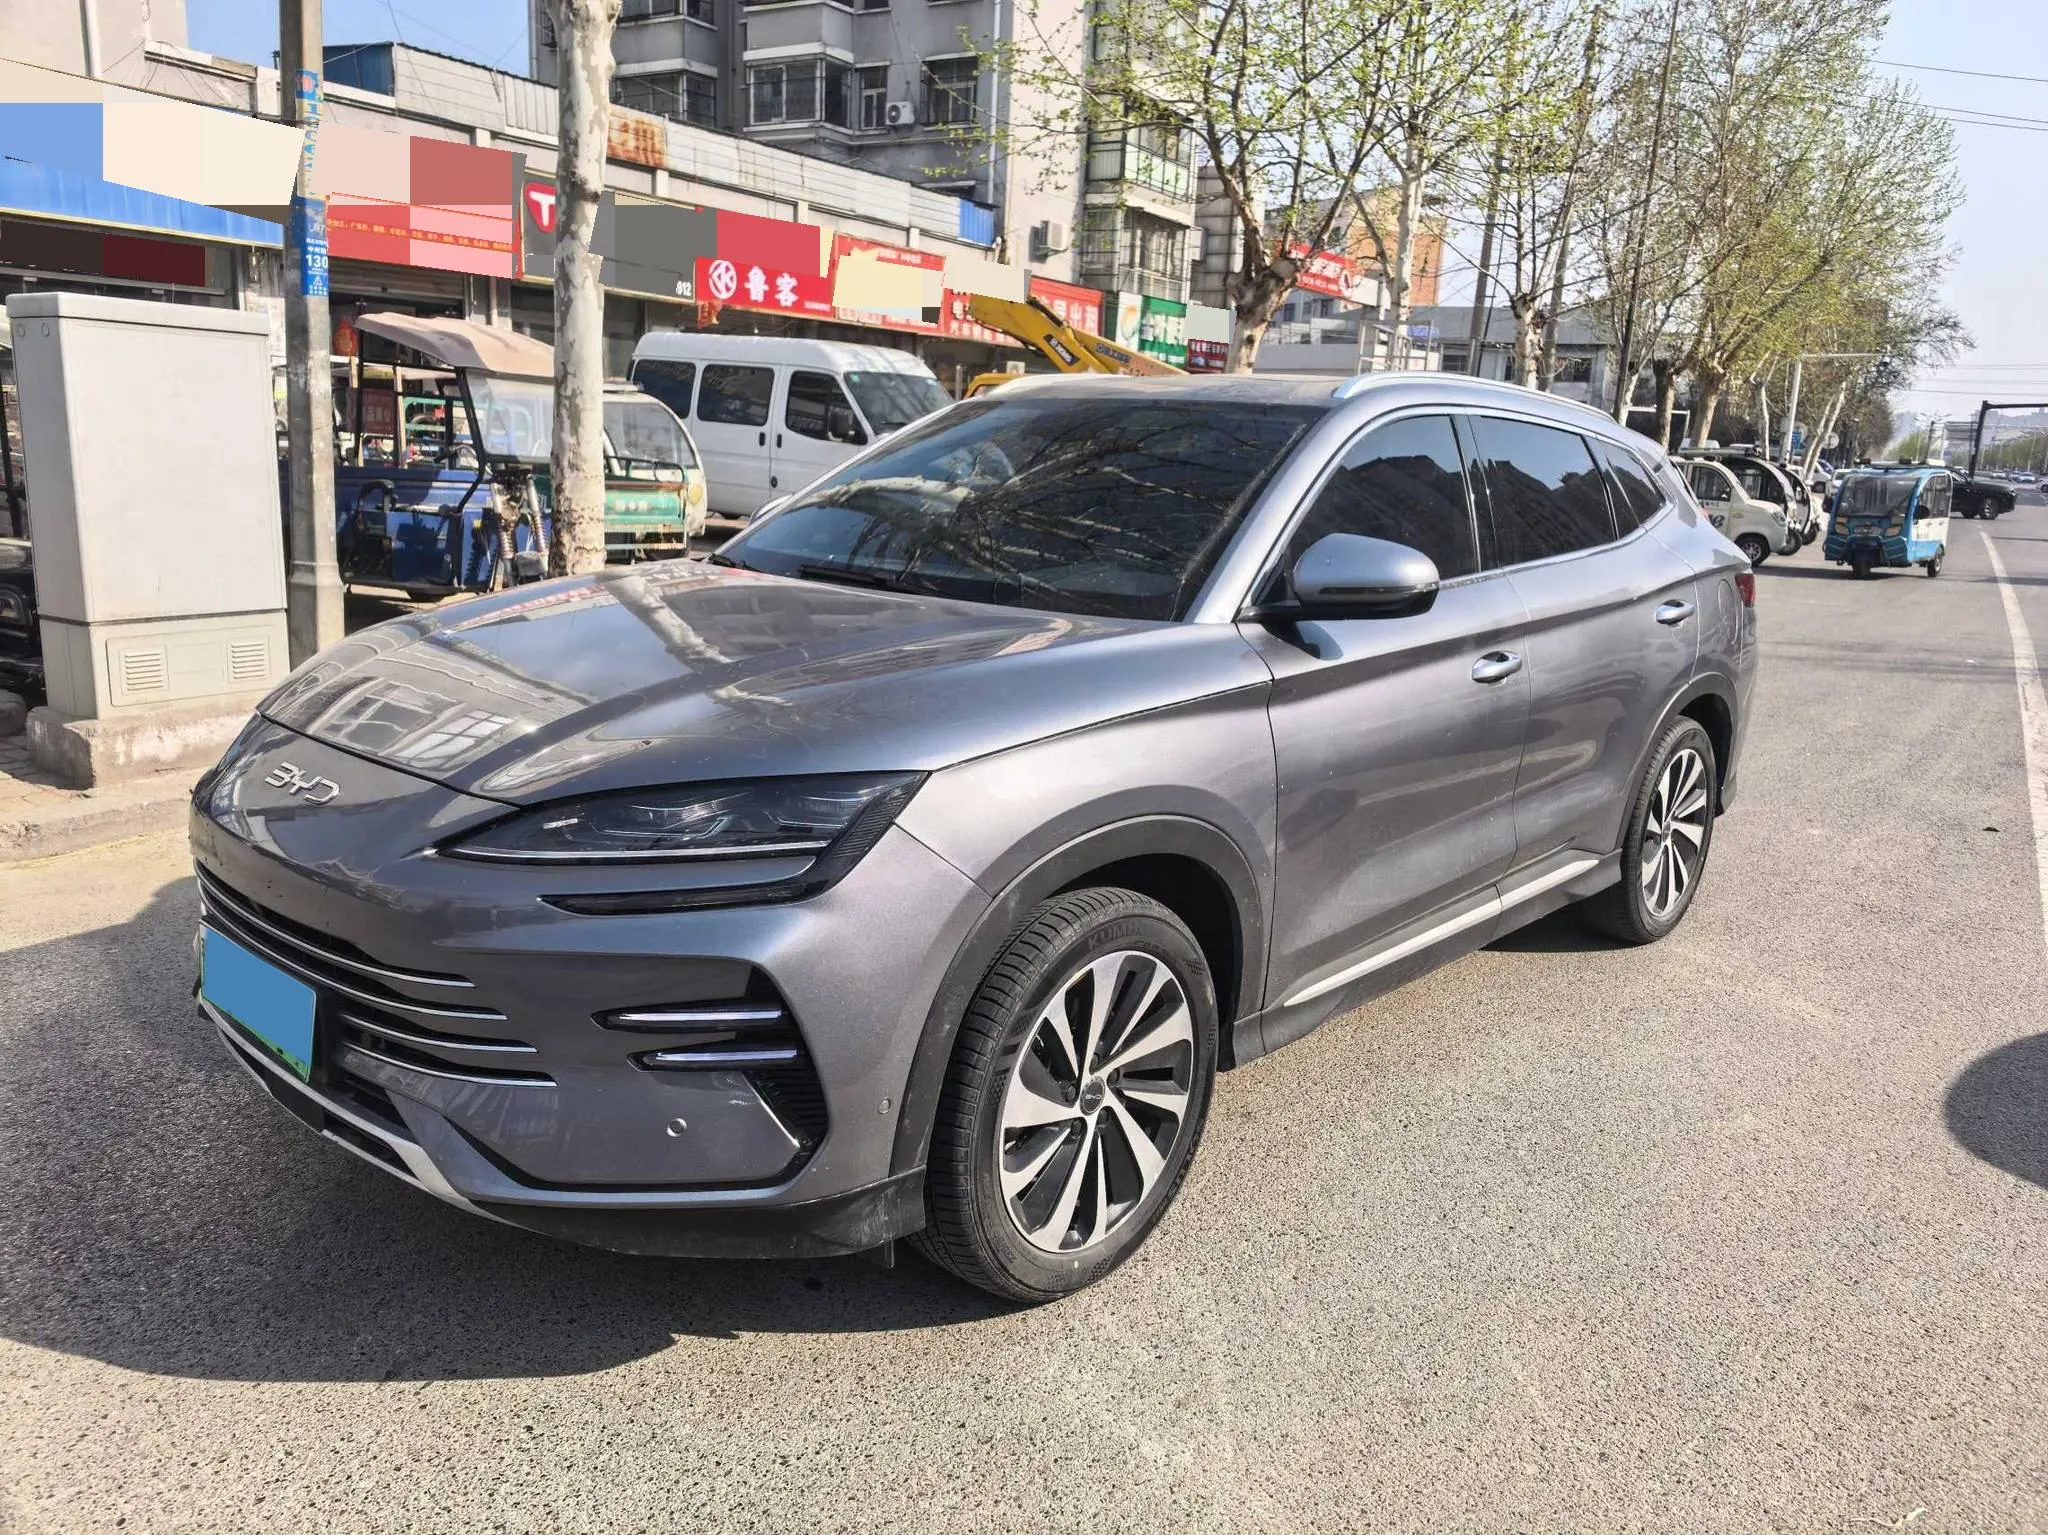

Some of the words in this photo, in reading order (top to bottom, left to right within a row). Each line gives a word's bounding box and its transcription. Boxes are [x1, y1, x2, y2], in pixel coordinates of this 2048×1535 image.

[305, 253, 329, 269] 130
[744, 265, 799, 307] 鲁客
[264, 761, 340, 805] BYD
